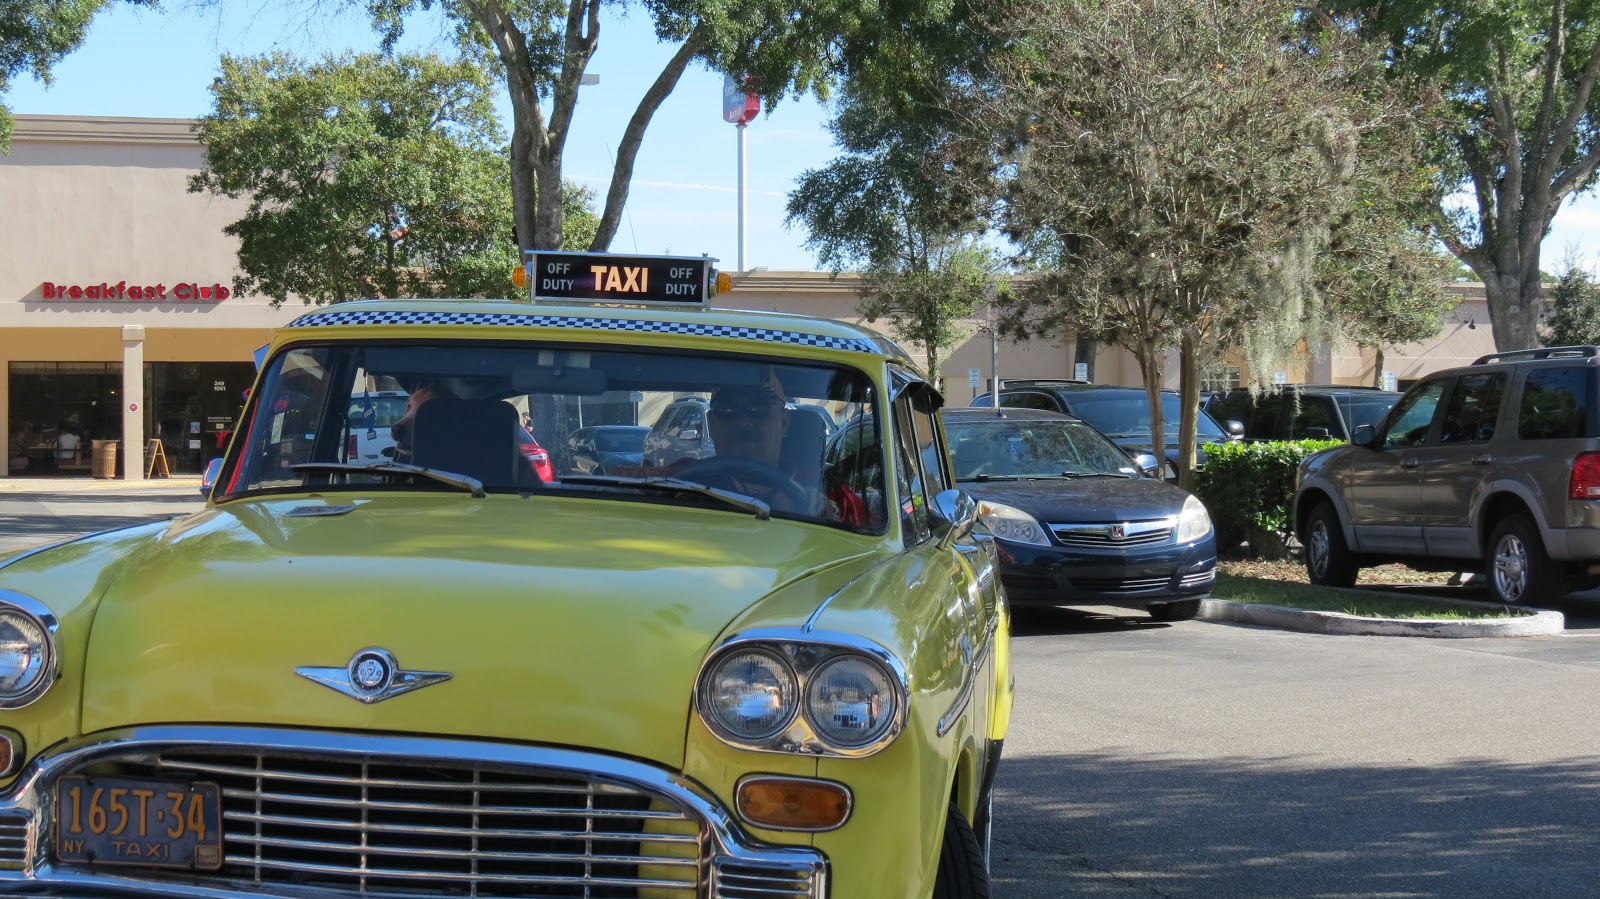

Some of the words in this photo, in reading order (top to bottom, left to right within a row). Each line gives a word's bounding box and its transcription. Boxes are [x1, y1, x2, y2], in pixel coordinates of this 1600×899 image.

[547, 263, 571, 275] OFF
[669, 267, 694, 279] OFF
[542, 278, 575, 291] DUTY
[590, 265, 649, 293] TAXI
[42, 280, 167, 300] Breakfast
[665, 283, 697, 295] DUTY
[64, 840, 86, 854] NY
[111, 840, 169, 857] TAXI
